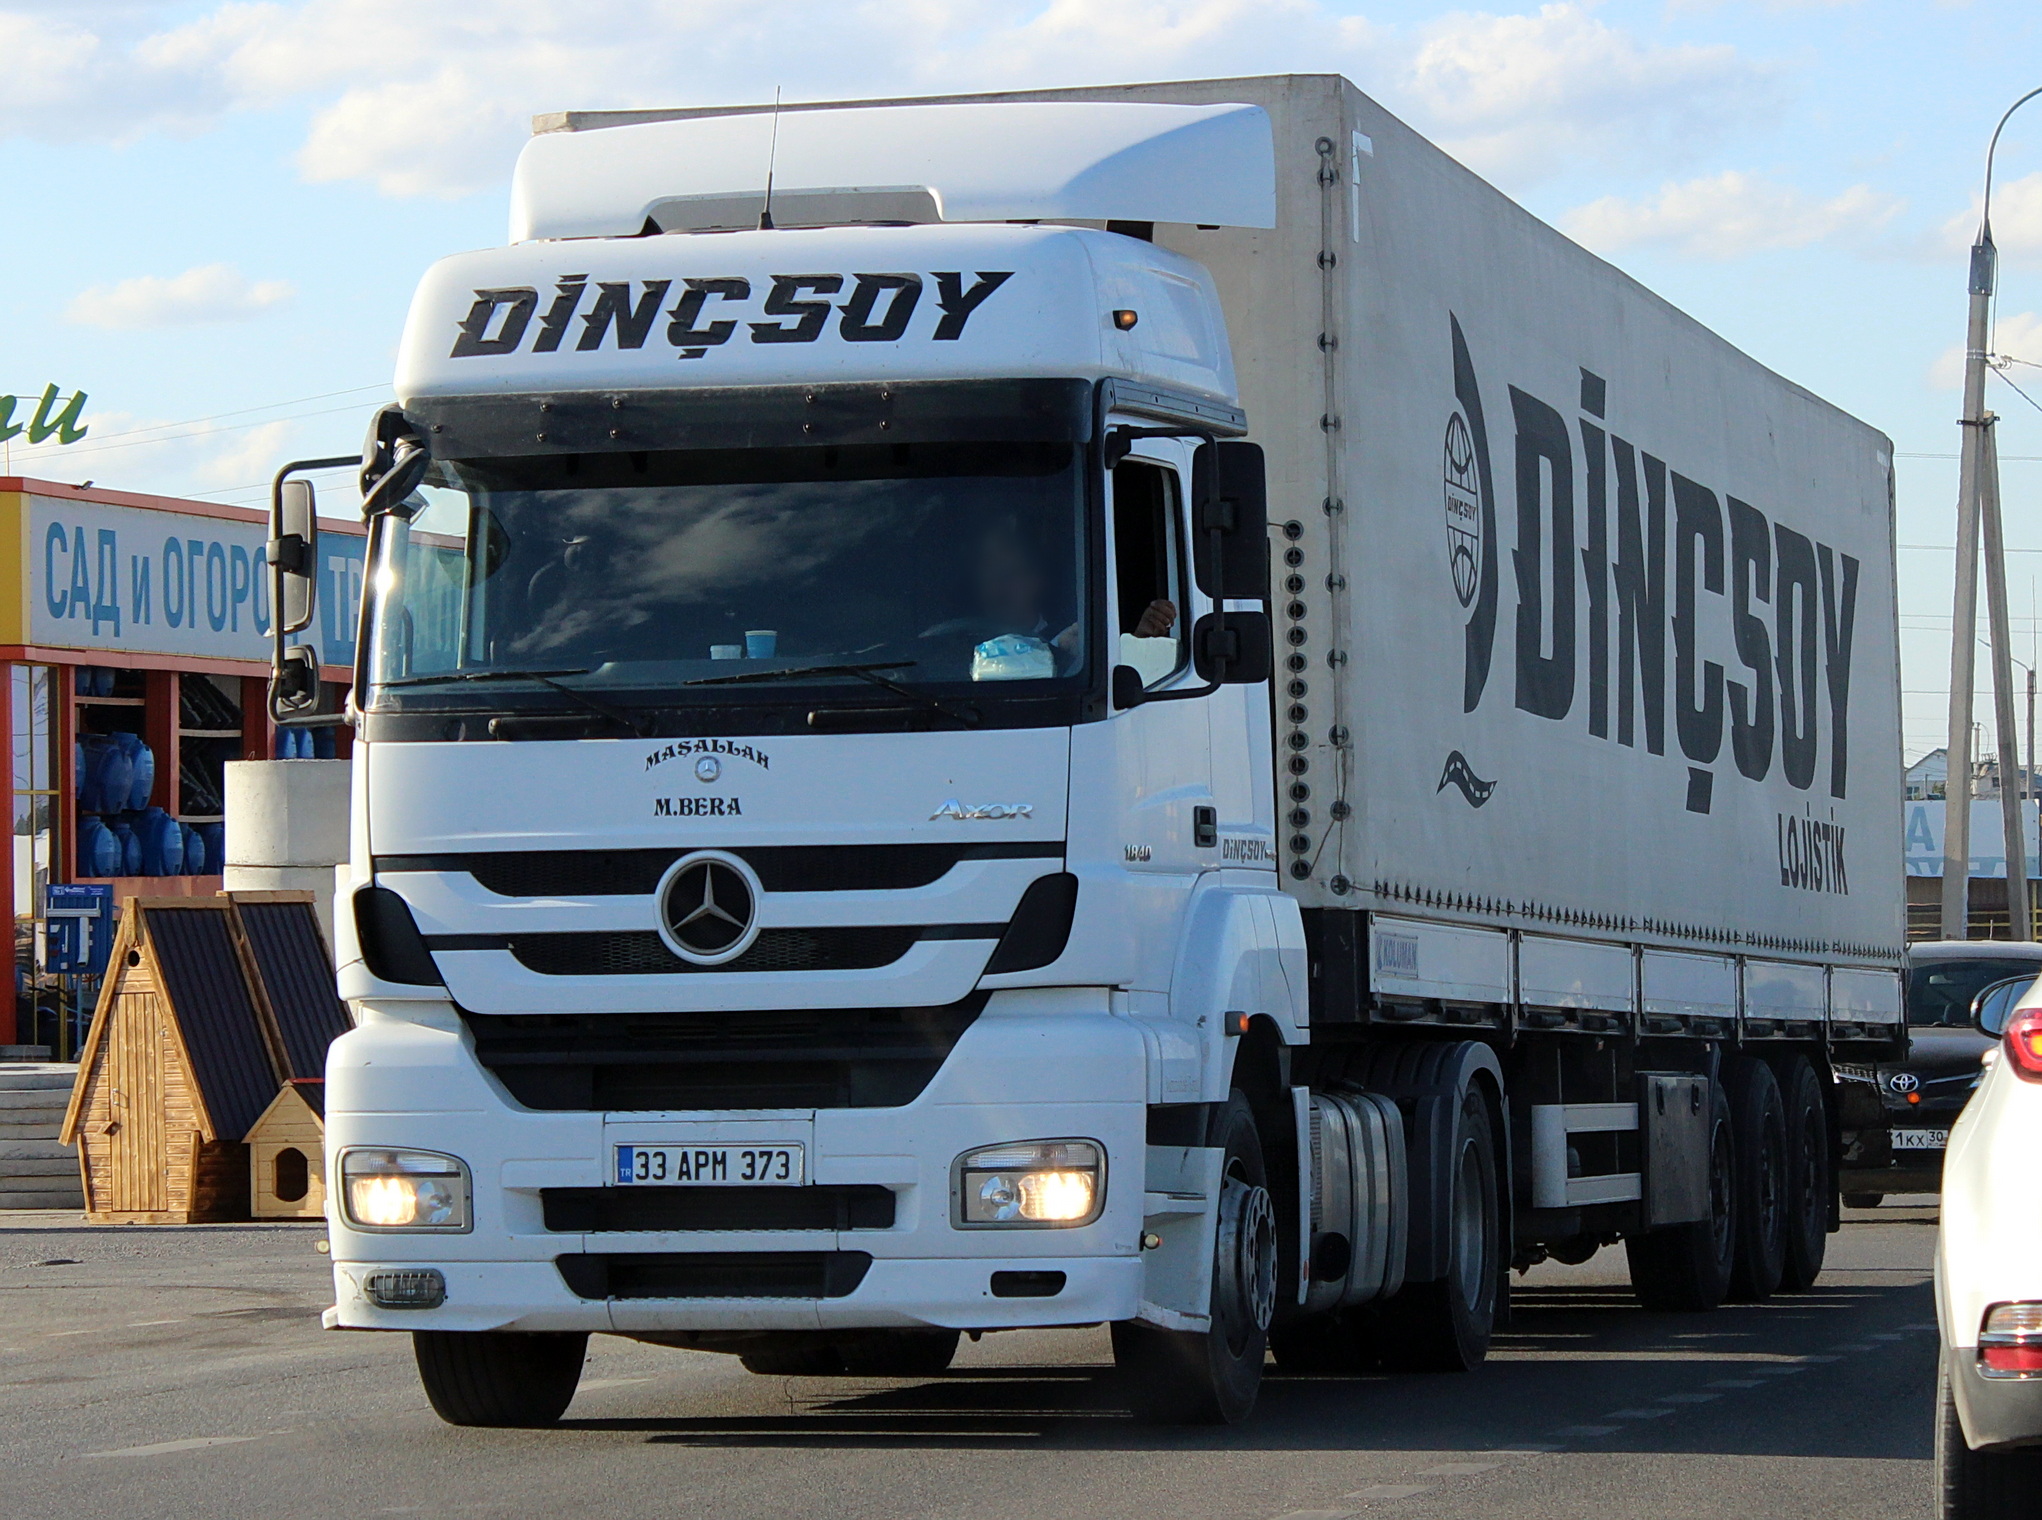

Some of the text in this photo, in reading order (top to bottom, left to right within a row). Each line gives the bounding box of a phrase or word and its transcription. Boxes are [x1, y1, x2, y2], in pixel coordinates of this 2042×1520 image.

[45, 521, 299, 646] САД и ОГОРО
[654, 797, 742, 817] M.BERA
[1125, 843, 1152, 862] 1840
[1929, 1131, 1943, 1142] 30
[620, 1151, 790, 1181] TR 33 APM 373
